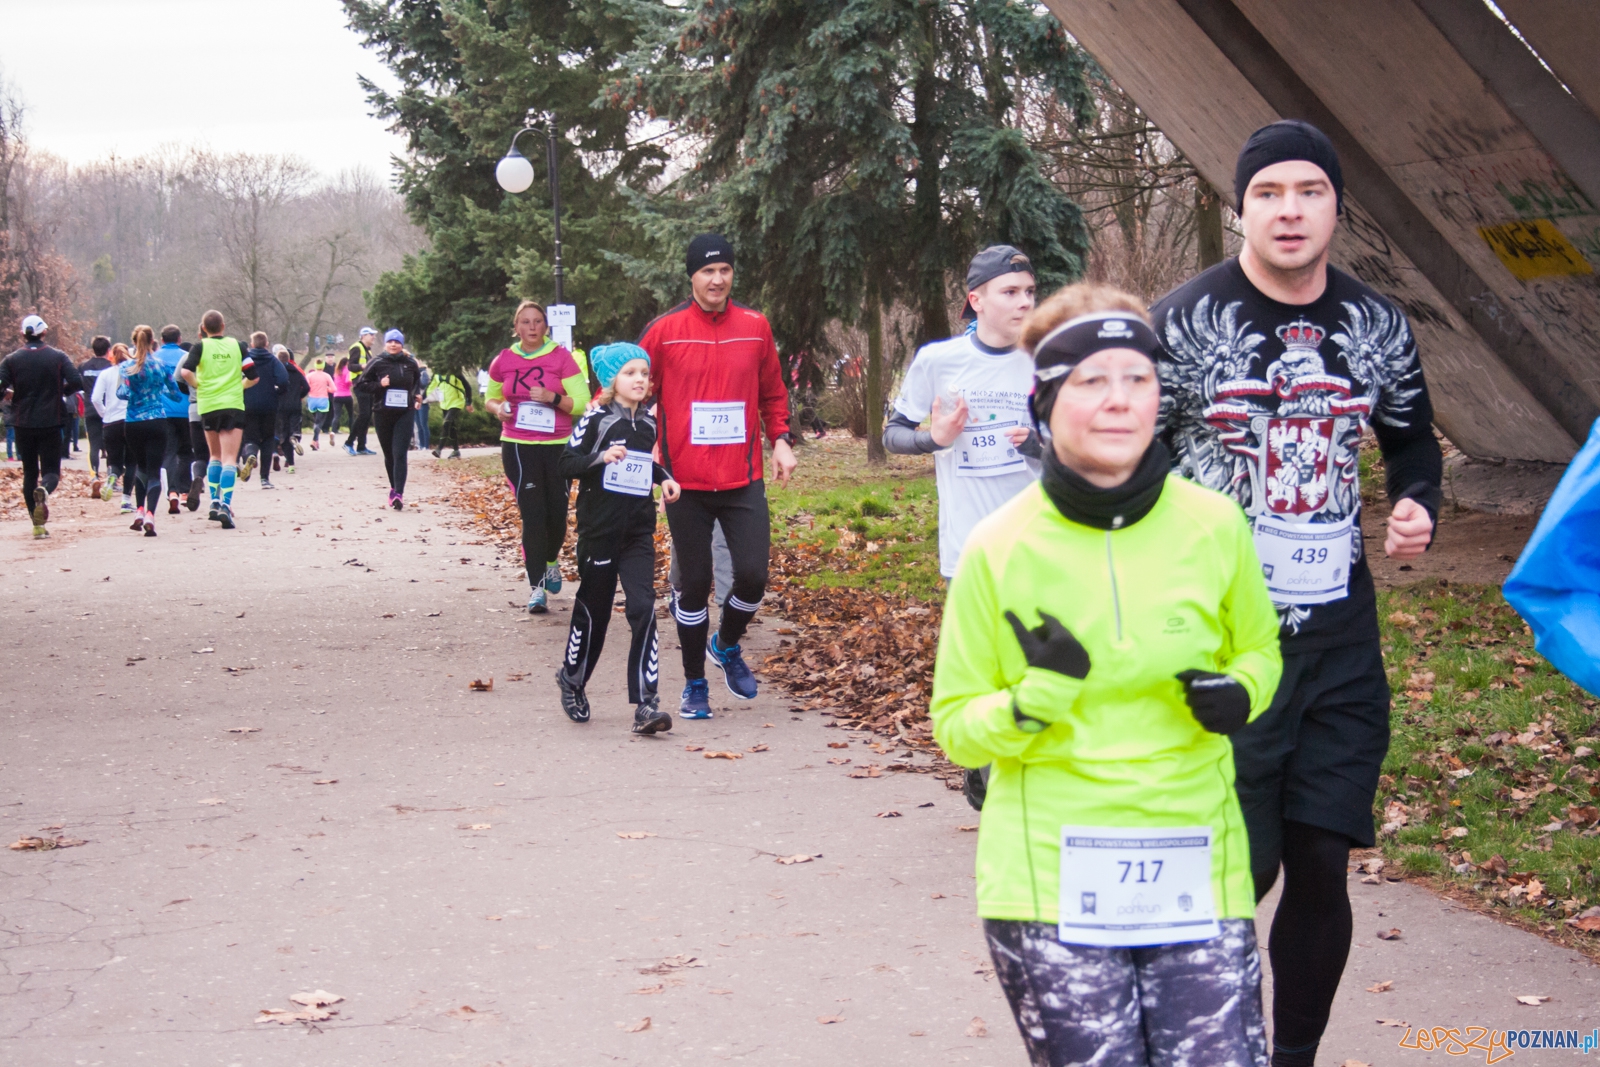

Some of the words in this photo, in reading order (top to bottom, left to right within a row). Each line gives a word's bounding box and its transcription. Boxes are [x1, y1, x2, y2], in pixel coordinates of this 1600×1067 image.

[529, 408, 543, 416] 396
[711, 414, 729, 424] 773
[972, 434, 996, 448] 438
[625, 462, 643, 474] 877
[1291, 547, 1328, 564] 439
[1094, 838, 1141, 848] POWSTANIA
[1142, 838, 1205, 848] WIELKOPOLSKIEGO
[1117, 860, 1164, 883] 717
